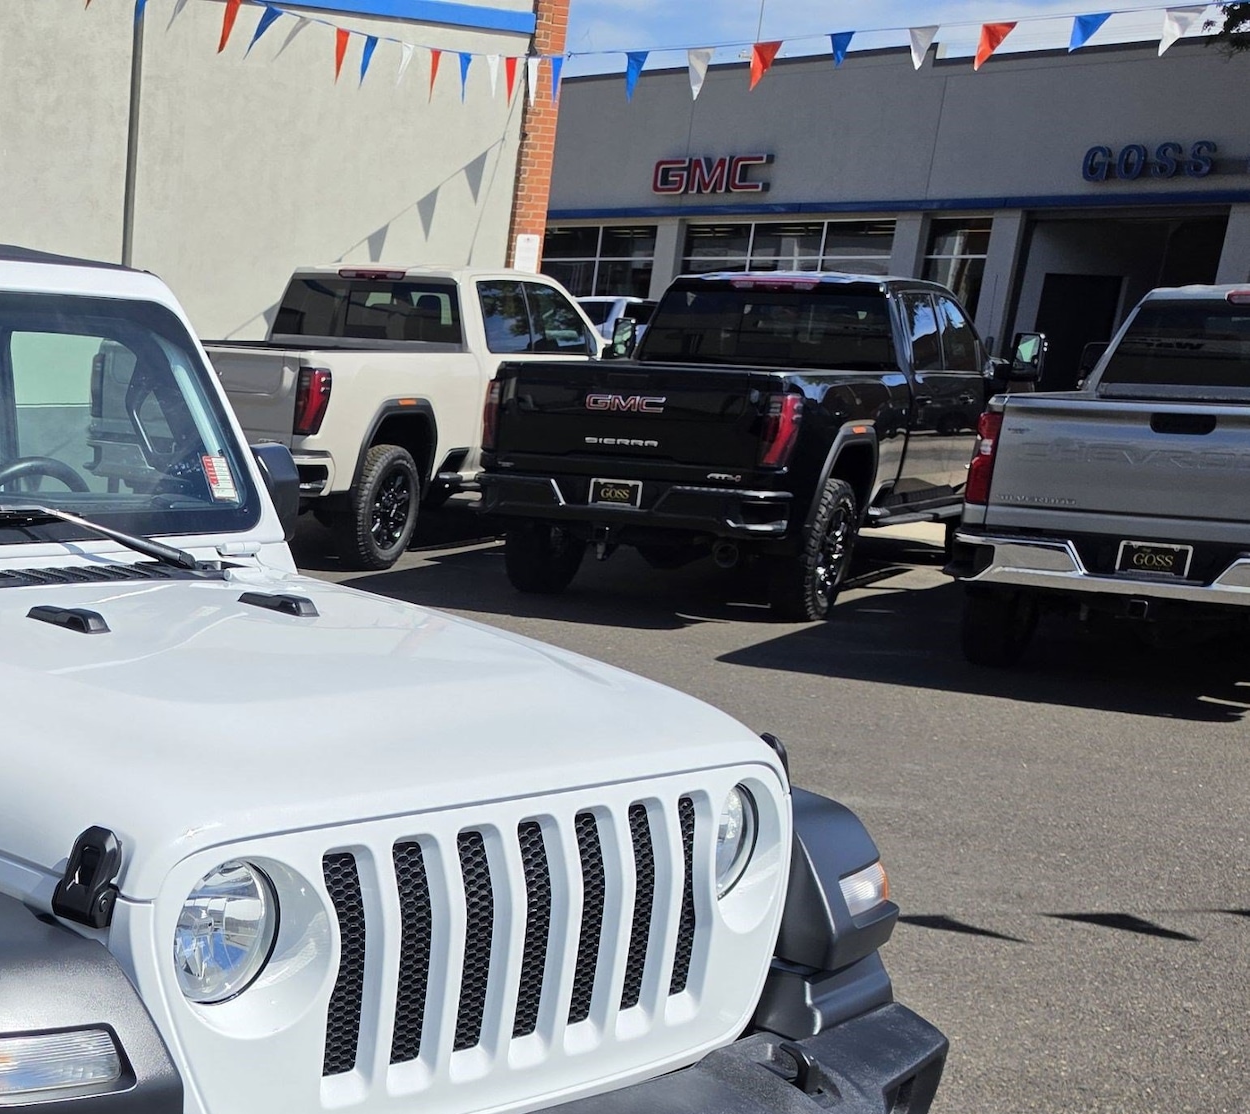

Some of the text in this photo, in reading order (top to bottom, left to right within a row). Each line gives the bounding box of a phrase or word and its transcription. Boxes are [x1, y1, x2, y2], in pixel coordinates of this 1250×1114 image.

[1082, 140, 1218, 182] GOSS
[652, 154, 772, 195] GMC
[586, 393, 667, 413] GMC
[584, 436, 659, 448] SIERRA
[600, 487, 630, 500] GOSS
[1133, 552, 1174, 567] GOSS
